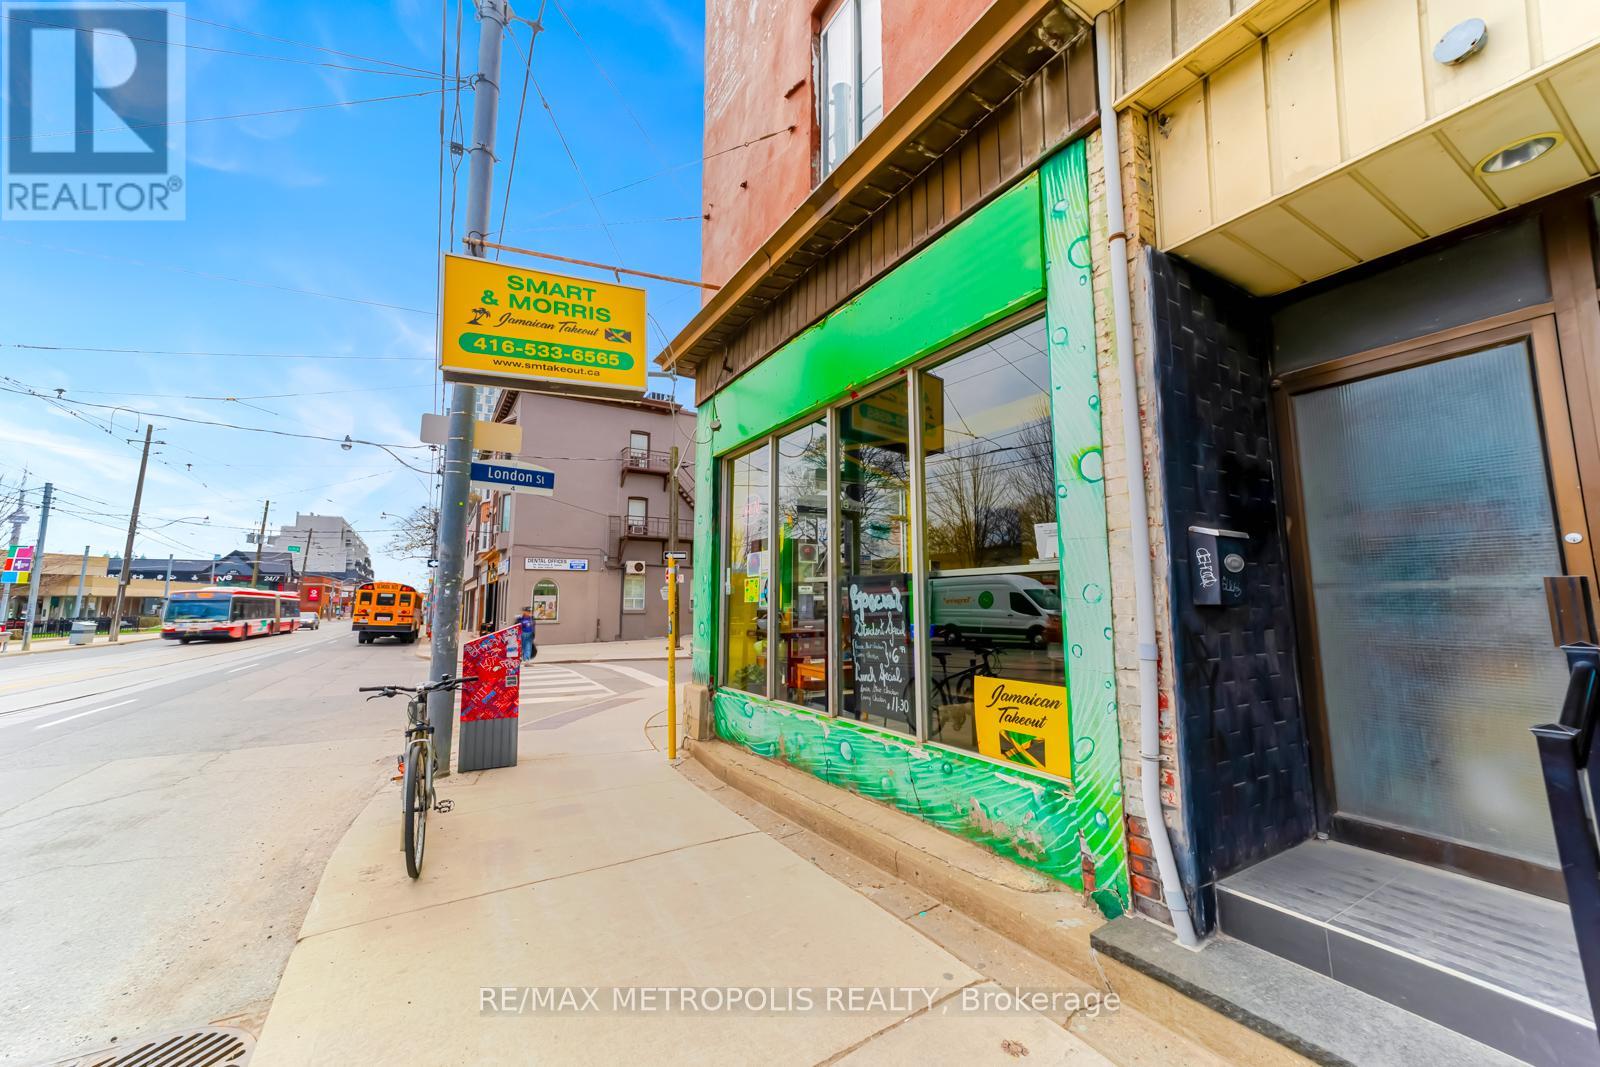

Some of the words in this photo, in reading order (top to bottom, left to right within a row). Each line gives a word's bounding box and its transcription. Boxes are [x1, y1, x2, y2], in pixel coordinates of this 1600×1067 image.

[507, 274, 597, 303] SMART
[481, 289, 499, 306] &
[509, 293, 612, 323] MORRIS
[493, 312, 556, 331] Jamaican
[558, 321, 600, 337] Takeout
[473, 337, 621, 367] 416-533-6565
[493, 358, 601, 377] www.smtakeout.ca
[488, 466, 533, 483] London
[536, 475, 545, 485] St
[855, 662, 877, 683] Lunch
[985, 684, 1063, 710] Jamaican
[998, 706, 1049, 729] Takeout
